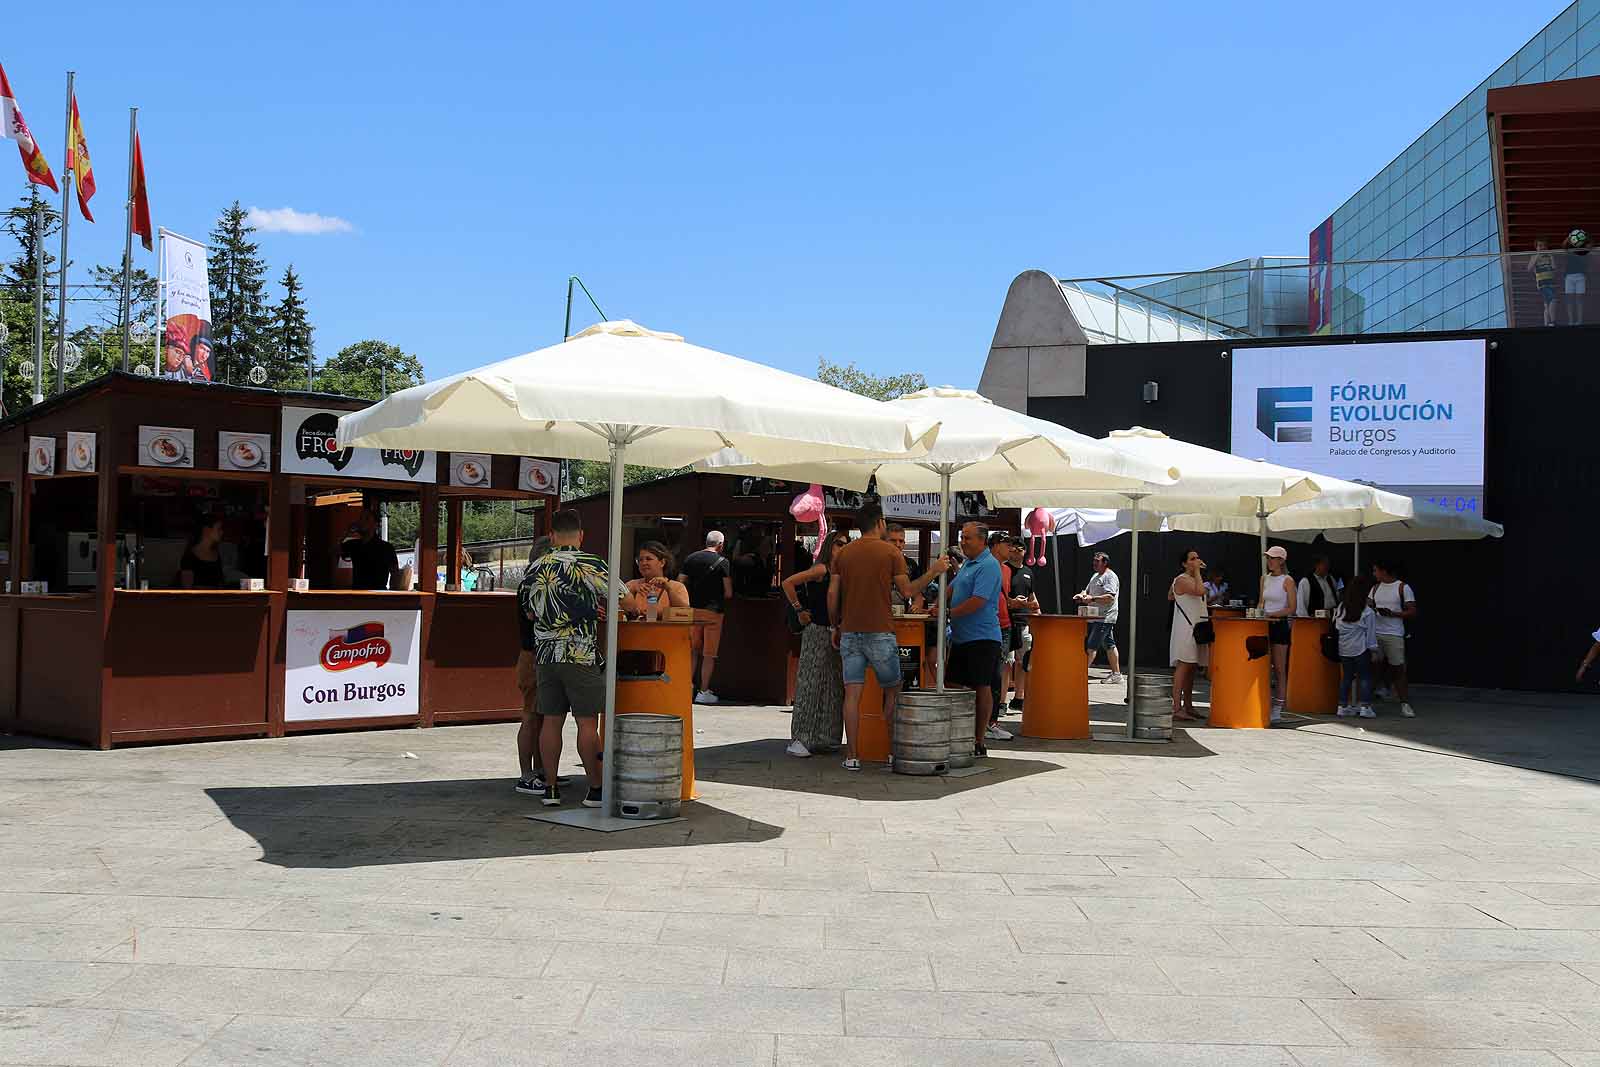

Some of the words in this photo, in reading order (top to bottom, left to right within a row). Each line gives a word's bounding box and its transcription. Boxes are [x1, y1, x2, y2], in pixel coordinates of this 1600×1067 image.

[1330, 380, 1407, 402] FÓRUM
[1330, 400, 1453, 422] EVOLUCIÓN
[1329, 426, 1397, 447] Burgos
[1329, 448, 1357, 456] Palacio
[1358, 447, 1368, 455] de
[1369, 447, 1411, 457] Congresos
[1412, 449, 1418, 457] y
[1418, 447, 1456, 456] Auditorio
[302, 685, 339, 704] Con
[343, 682, 406, 702] Burgos
